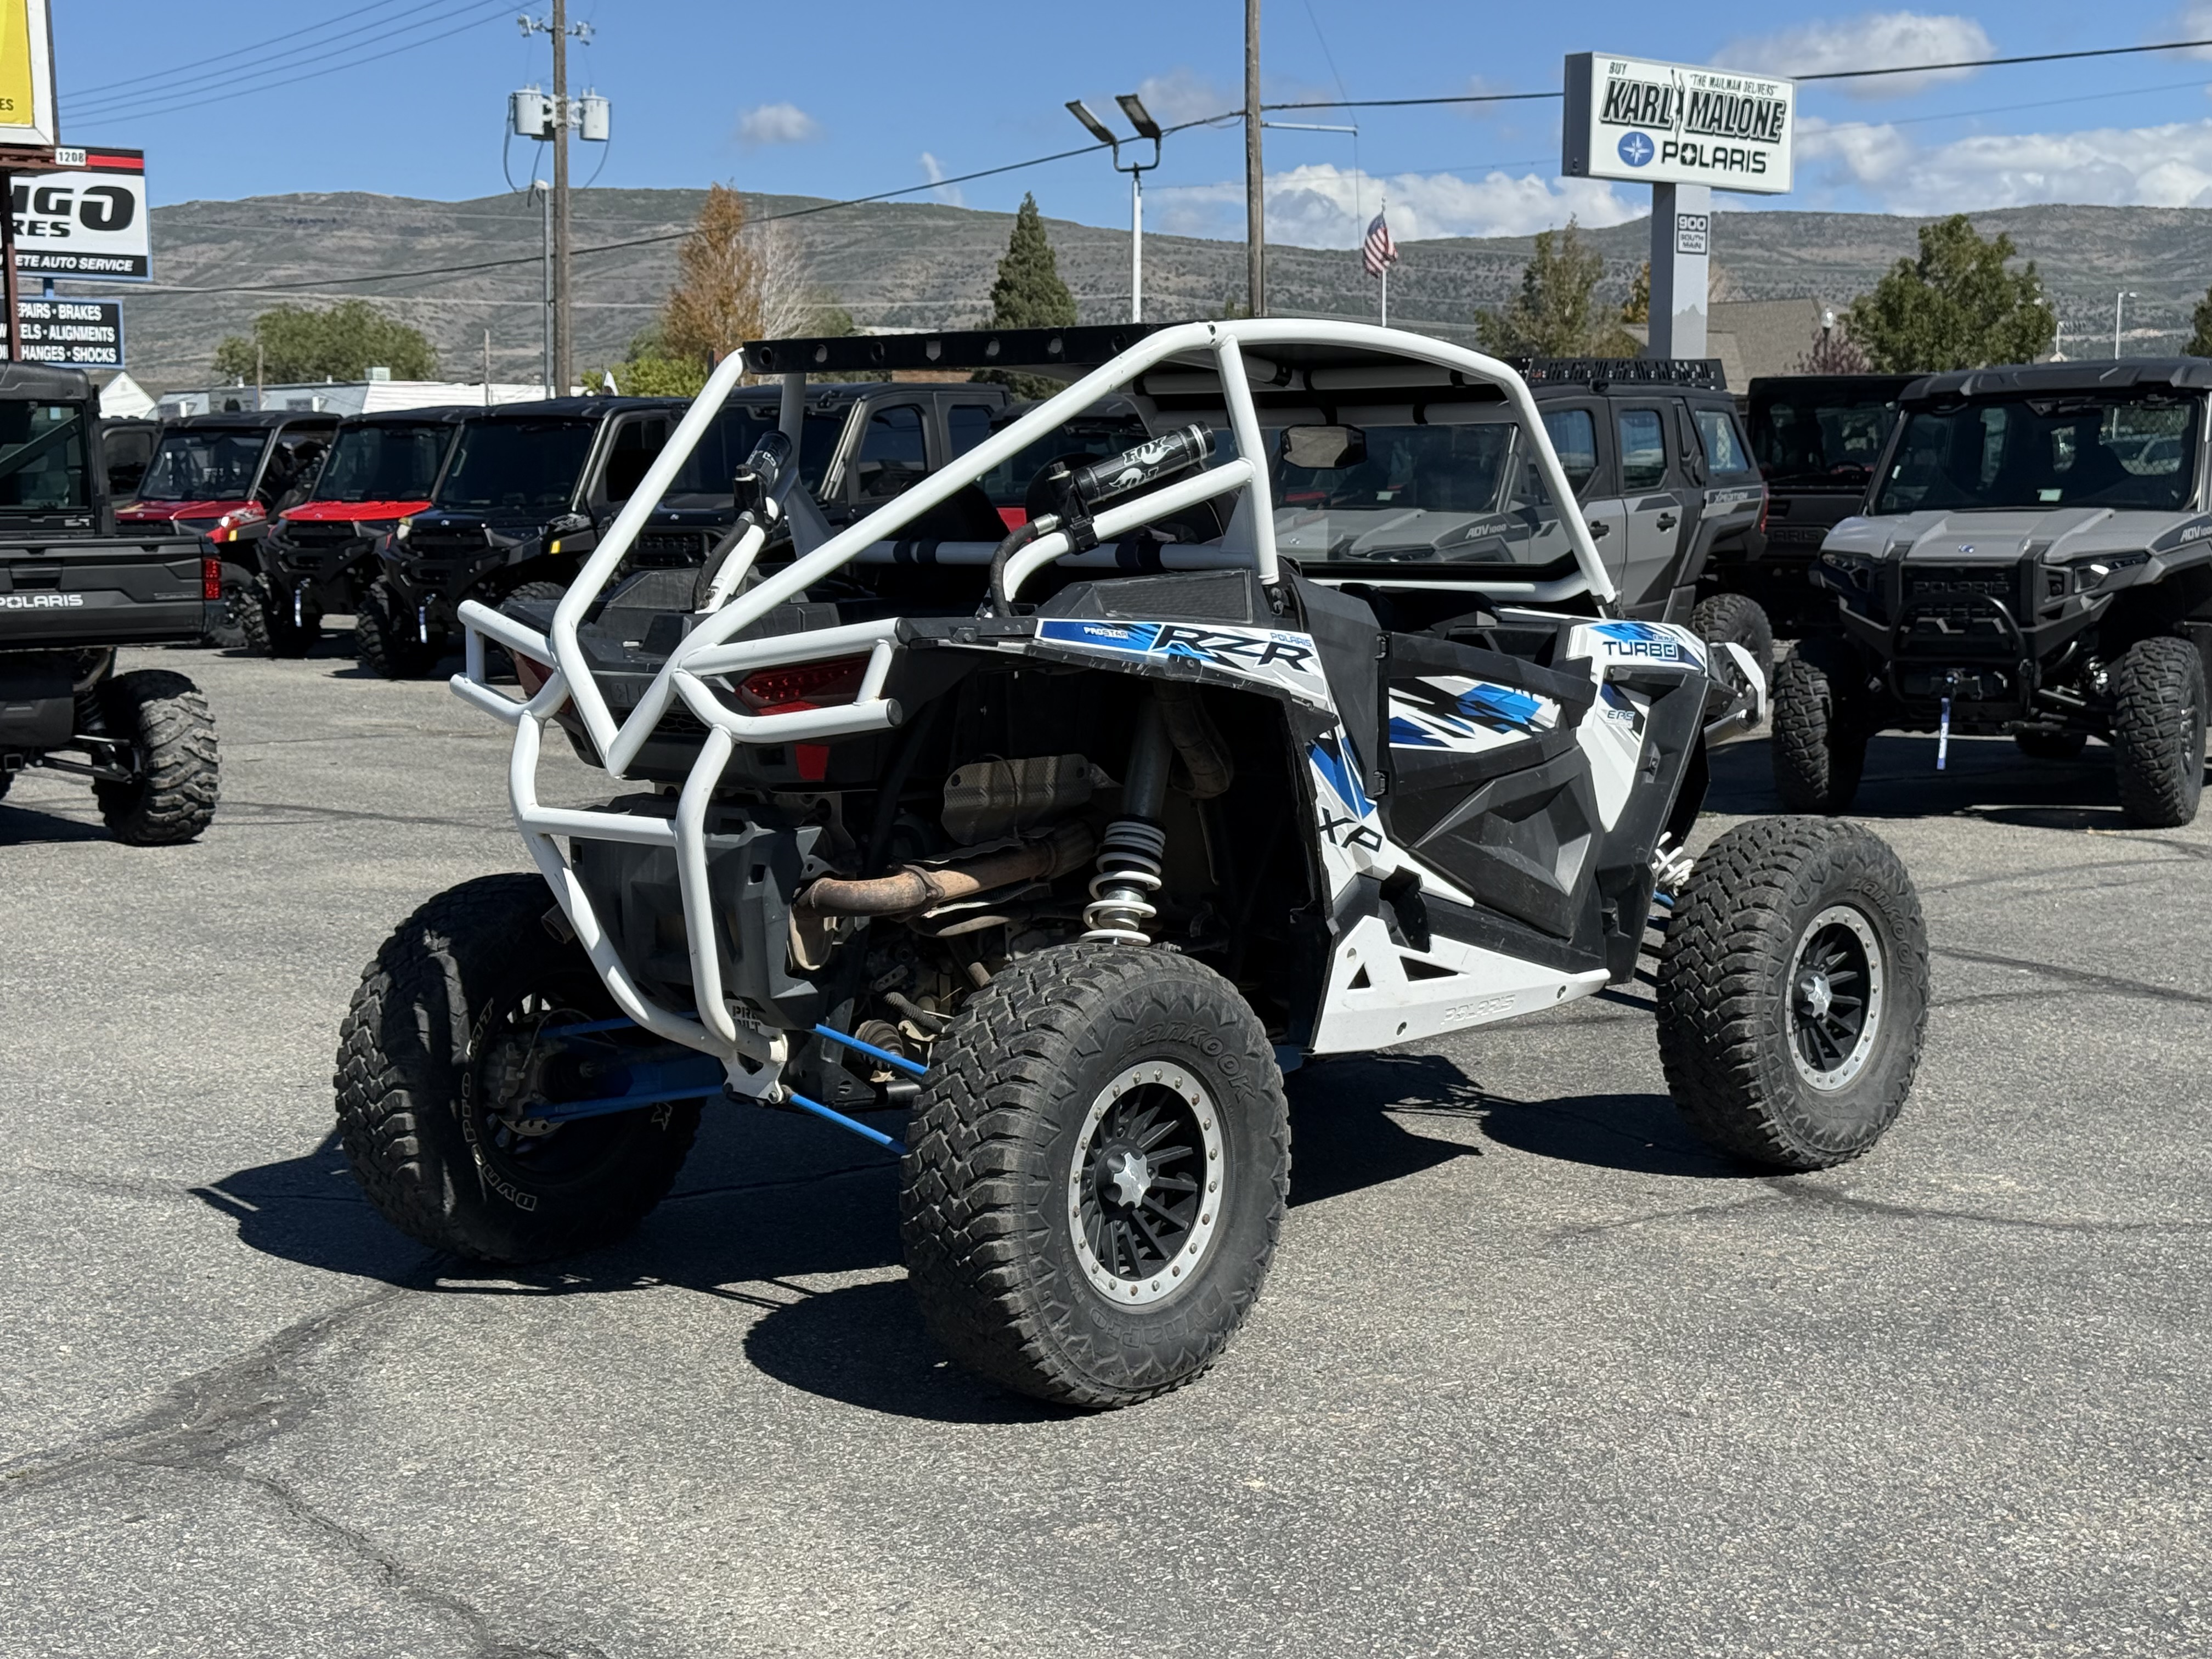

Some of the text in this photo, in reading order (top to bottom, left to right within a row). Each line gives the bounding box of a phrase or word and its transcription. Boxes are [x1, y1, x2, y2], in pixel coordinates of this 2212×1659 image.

[1609, 61, 1627, 75] BUY
[1599, 77, 1786, 144] KARL MALONE
[59, 151, 84, 162] 1208
[1661, 140, 1767, 174] POLARIS
[1679, 216, 1707, 230] 900
[41, 256, 77, 269] AUTO
[78, 259, 134, 272] SERVICE
[58, 304, 103, 321] BRAKES
[48, 325, 115, 343] ALIGNMENTS
[21, 345, 66, 362] HANGES
[72, 346, 117, 363] SHOCKS
[1122, 435, 1175, 464] FOX
[1082, 626, 1129, 640] PROSTAR
[1269, 632, 1313, 647] POLARIS
[1151, 624, 1316, 675] RZR
[1602, 641, 1678, 658] TURBO
[1607, 709, 1635, 721] EPS
[1318, 806, 1383, 853] XP
